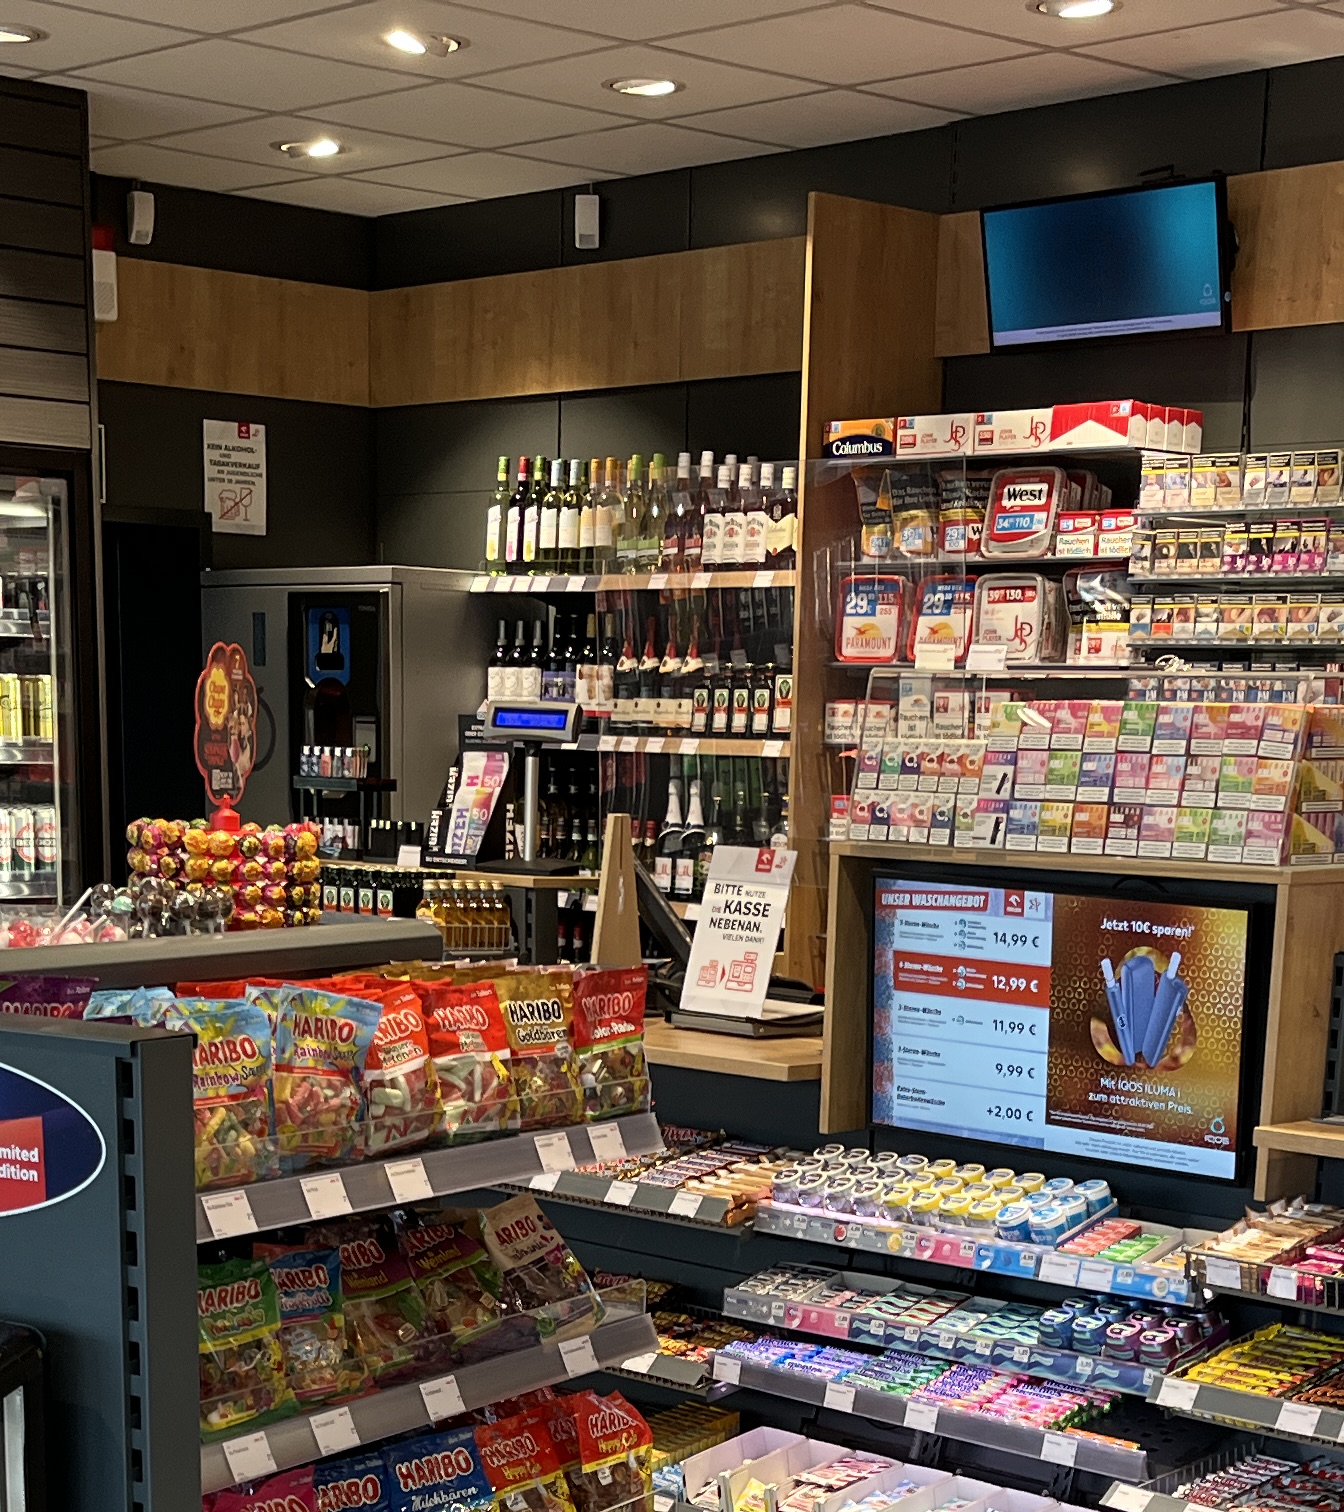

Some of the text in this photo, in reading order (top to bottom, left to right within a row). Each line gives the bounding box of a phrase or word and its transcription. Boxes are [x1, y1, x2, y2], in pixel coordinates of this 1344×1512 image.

[832, 440, 883, 456] Columbus
[1007, 486, 1044, 502] West
[845, 636, 892, 650] PARAMOUNT
[714, 883, 744, 896] BITTE
[723, 899, 772, 918] KASSE
[881, 893, 986, 909] UNSER WASCHANGEBOT
[708, 916, 763, 934] NEBENAN.
[1100, 917, 1128, 931] Jetzt
[993, 931, 1040, 949] 14,99 €
[991, 975, 1039, 993] 12,99 €
[508, 998, 564, 1026] HARIBO
[581, 990, 638, 1019] HARIBO
[292, 1012, 357, 1045] HARIBO
[992, 1019, 1037, 1037] 11,99 €
[994, 1062, 1036, 1081] 9,99 €
[1100, 1077, 1116, 1089] Mit
[1088, 1092, 1109, 1104] zum
[1109, 1092, 1167, 1112] attraktiven
[986, 1104, 1023, 1123] +2,00
[1023, 1109, 1034, 1122] €
[480, 1432, 540, 1468] HARIBO
[394, 1446, 475, 1492] HARIBO
[411, 1484, 479, 1512] Milchbären
